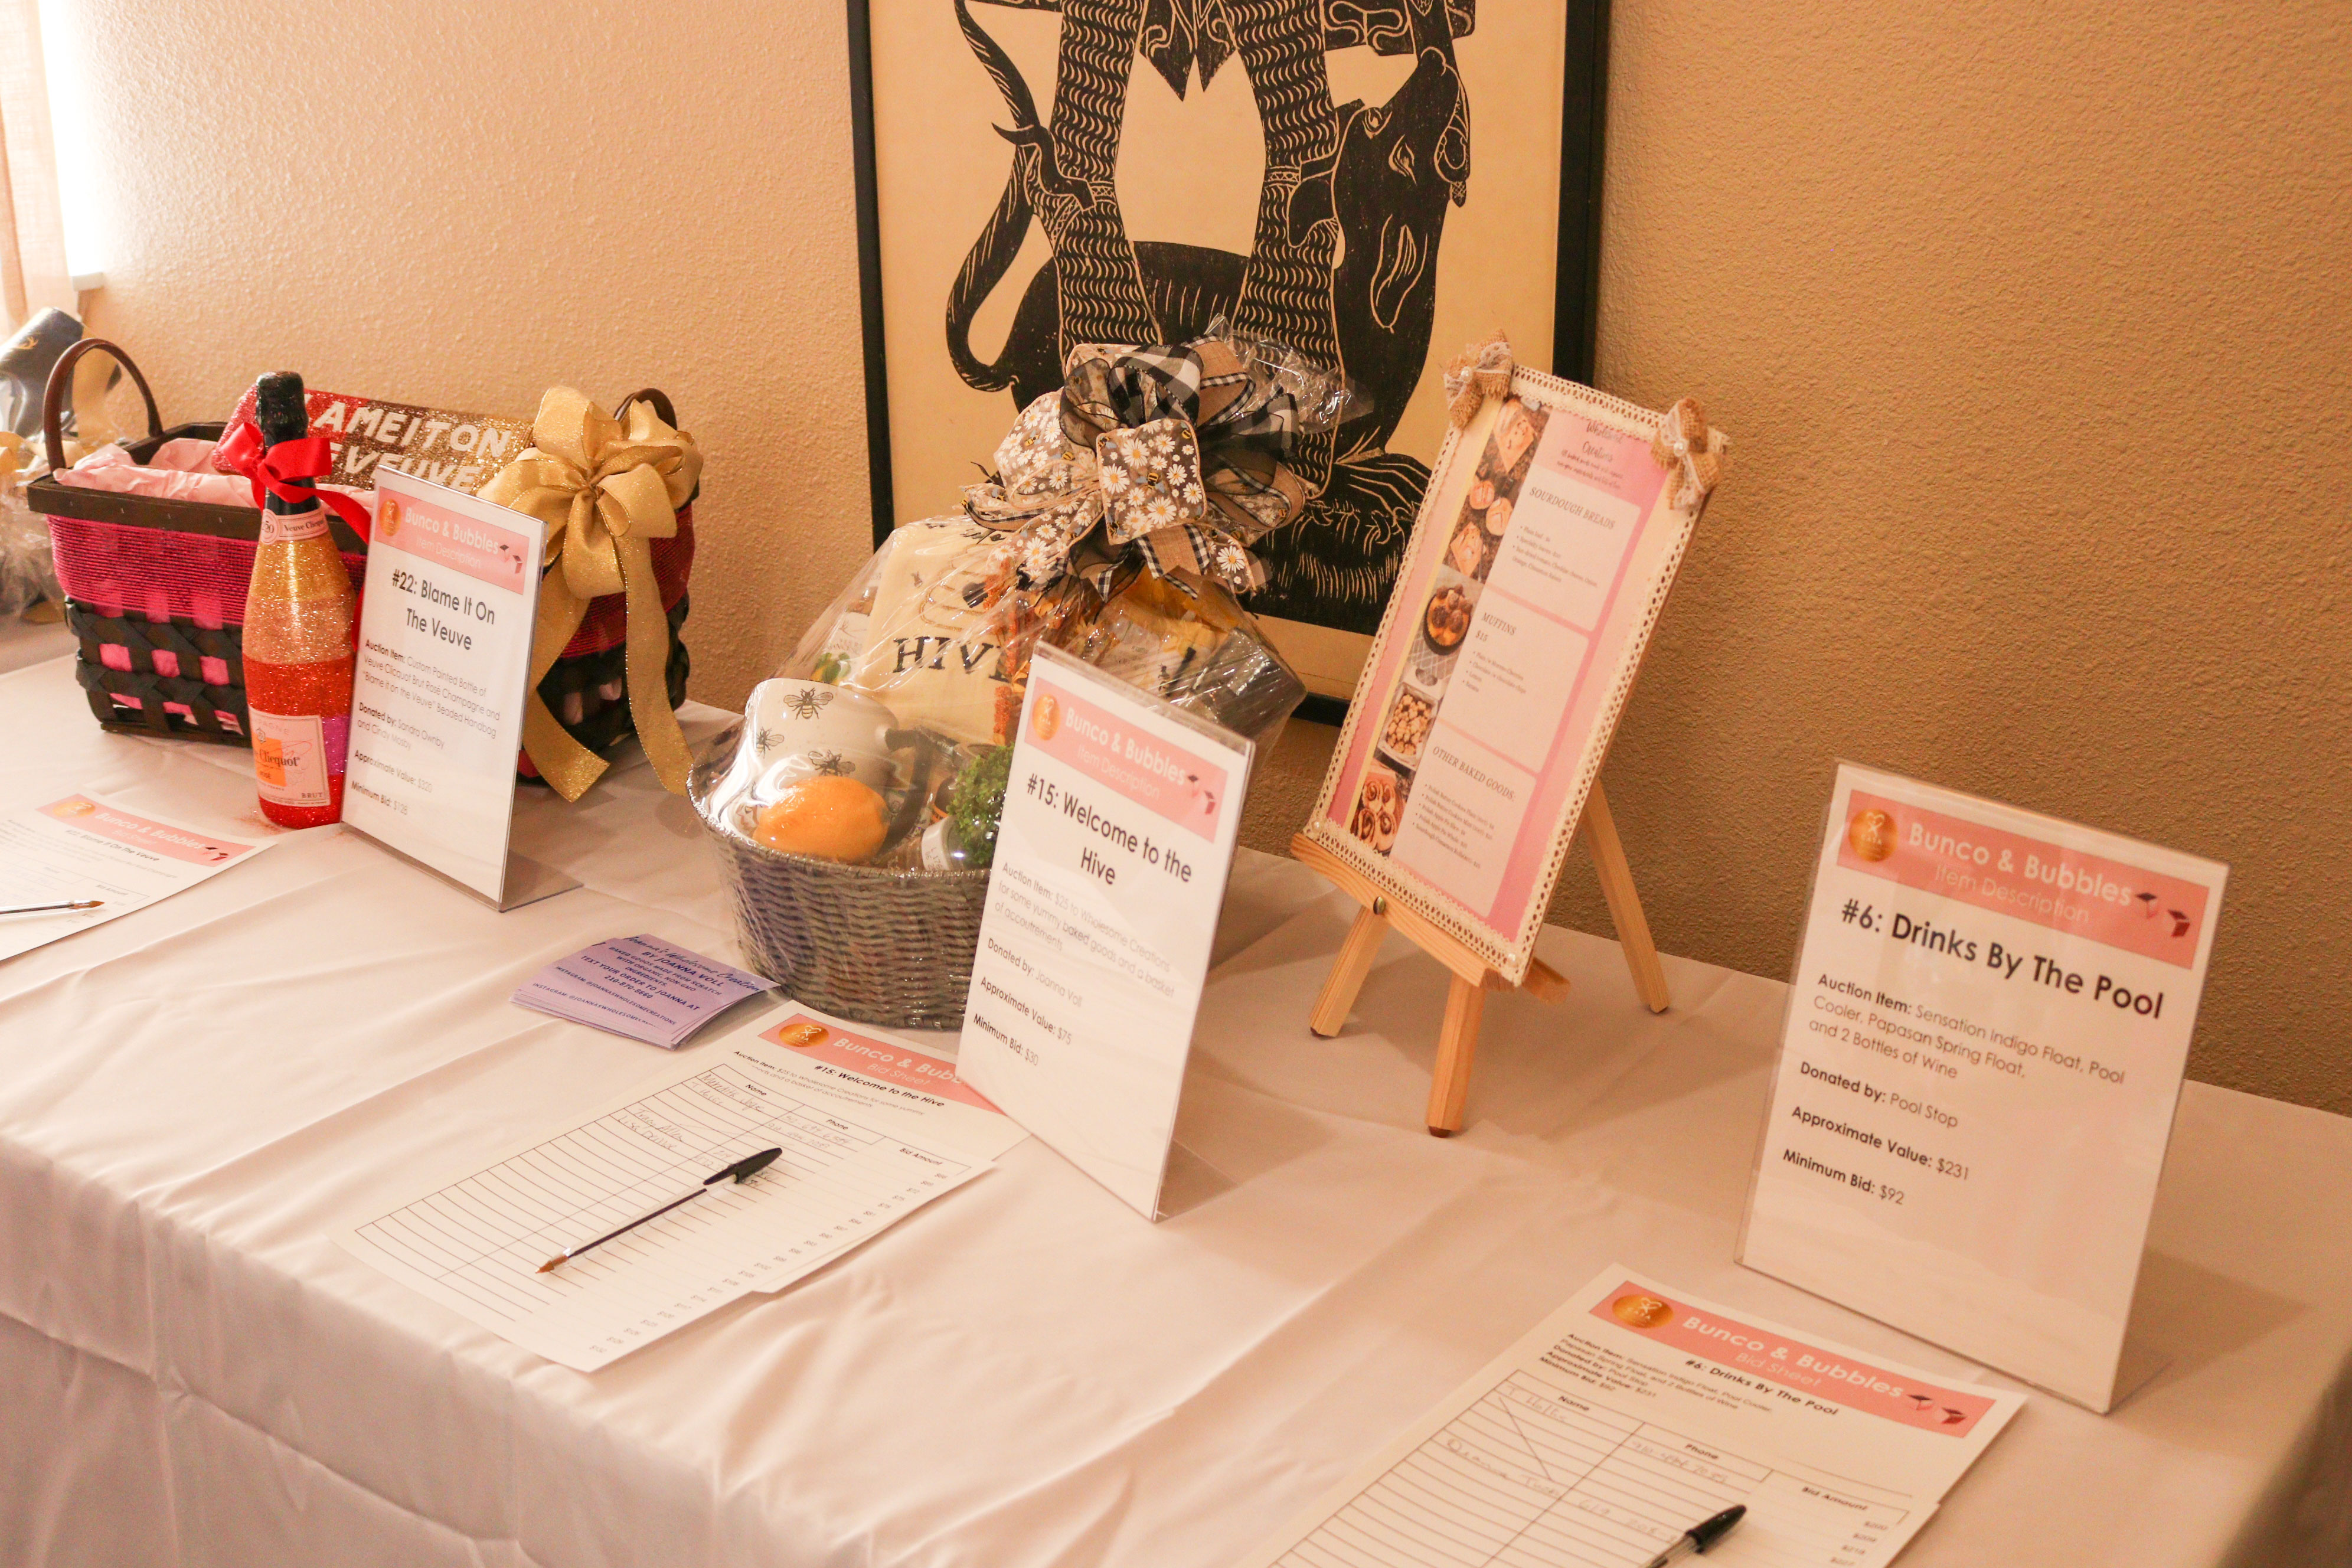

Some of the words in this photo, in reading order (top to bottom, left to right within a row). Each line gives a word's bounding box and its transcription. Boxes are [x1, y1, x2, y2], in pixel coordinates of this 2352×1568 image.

[405, 507, 439, 534] Bunco
[442, 521, 449, 537] &
[453, 526, 499, 555] Bubbles
[1529, 486, 1583, 521] SOURDOUGH
[1583, 508, 1616, 530] BREADS
[436, 543, 482, 569] Description
[392, 569, 419, 594] #22:
[421, 580, 460, 612] Blame
[463, 596, 472, 616] It
[476, 602, 495, 625] On
[407, 608, 427, 632] The
[432, 618, 472, 651] Veuve
[1480, 612, 1517, 637] MUFFINS
[365, 639, 388, 656] Auction
[390, 649, 405, 663] Item:
[407, 656, 432, 674] Custom
[433, 667, 458, 685] Painted
[459, 678, 478, 694] Bottle
[479, 688, 487, 697] of
[892, 636, 1010, 683] HIV
[359, 702, 386, 721] Donated
[387, 714, 397, 727] by:
[437, 703, 463, 722] Beaded
[464, 714, 496, 739] Handbag
[443, 688, 485, 714] Champagne
[486, 709, 501, 721] and
[354, 749, 395, 775] Approximate
[1065, 708, 1109, 746] Bunco
[1110, 731, 1121, 752] &
[1125, 737, 1186, 787] Bubbles
[351, 780, 380, 801] Minimum
[1077, 744, 1100, 767] Item
[1101, 757, 1161, 801] Description
[1432, 745, 1459, 770] OTHER
[1458, 760, 1487, 785] BAKED
[1485, 777, 1517, 803] GOODS:
[94, 812, 139, 829] Bunco
[149, 829, 207, 850] Bubbles
[1027, 773, 1059, 809] #15:
[1064, 791, 1138, 852] Welcome
[1143, 837, 1159, 864] to
[1164, 848, 1192, 882] the
[136, 851, 160, 861] Veuve
[1080, 847, 1116, 886] Hive
[1908, 822, 1990, 865] Bunco
[1997, 850, 2014, 874] &
[2024, 854, 2132, 906] Bubbles
[1002, 862, 1032, 887] Auction
[1033, 880, 1053, 901] Item:
[1935, 865, 1976, 890] Item
[1982, 878, 2090, 923] Description
[1005, 907, 1063, 951] accoutrements
[1010, 889, 1031, 909] some
[1034, 903, 1061, 930] yummy
[1063, 922, 1090, 945] baked
[1118, 957, 1136, 974] and
[1145, 971, 1175, 998] basket
[555, 966, 587, 983] INSTAGRAM:
[581, 955, 599, 965] TEXT
[600, 964, 620, 974] YOUR
[620, 973, 646, 986] ORDER
[655, 990, 688, 1005] JOANNA
[609, 947, 631, 956] BAKED
[631, 955, 653, 966] GOODS
[654, 965, 672, 974] MADE
[672, 973, 691, 982] FROM
[690, 981, 723, 995] SCRATCH
[616, 956, 634, 965] WITH
[664, 976, 697, 991] NON-GMO
[655, 958, 697, 975] JOANNA
[698, 974, 725, 987] VOLL
[988, 937, 1021, 967] Donated
[1023, 959, 1035, 976] by:
[1035, 969, 1066, 997] Joanna
[1841, 898, 1883, 933] #6:
[1891, 913, 1977, 961] Drinks
[1987, 942, 2023, 979] By
[2033, 955, 2084, 994] The
[2093, 974, 2165, 1020] Pool
[533, 982, 568, 998] INSTAGRAM:
[604, 975, 654, 999] 210-870-8660
[981, 976, 1030, 1016] Approximate
[1033, 1008, 1056, 1035] Value:
[1057, 1027, 1072, 1046] $75
[1818, 974, 1872, 1001] Auction
[1876, 991, 1912, 1015] Item:
[1916, 1005, 1986, 1039] Sensation
[1990, 1030, 2038, 1056] Indigo
[2089, 1060, 2125, 1084] Pool
[733, 1050, 760, 1064] Auction
[790, 1032, 809, 1041] CASA
[833, 1038, 894, 1062] Bunco
[897, 1059, 913, 1068] &
[974, 1014, 1008, 1045] Minimum
[1010, 1037, 1023, 1056] Bid:
[1024, 1048, 1039, 1066] $30
[1809, 1020, 1838, 1037] and
[1841, 1028, 1850, 1042] 2
[1853, 1032, 1899, 1059] Bottles
[1902, 1051, 1919, 1064] of
[1922, 1054, 1958, 1079] Wine
[1868, 1012, 1932, 1046] Papasan
[1935, 1035, 1981, 1064] Spring
[814, 1064, 837, 1077] #15:
[838, 1072, 887, 1091] Welcome
[901, 1092, 919, 1100] the
[920, 1097, 946, 1107] Hive
[867, 1063, 890, 1074] Bid
[890, 1070, 931, 1086] Sheet
[1800, 1061, 1861, 1093] Donated
[1864, 1084, 1887, 1103] by:
[1890, 1093, 1922, 1115] Pool
[1925, 1105, 1958, 1129] Stop
[744, 1083, 767, 1097] Name
[826, 1118, 849, 1131] Phone
[912, 1152, 943, 1166] Amount
[1791, 1106, 1882, 1148] Approximate
[1887, 1139, 1932, 1168] Value:
[1936, 1158, 1969, 1180] $231
[1783, 1148, 1846, 1183] Minimum
[1850, 1174, 1876, 1194] Bid:
[1879, 1184, 1905, 1206] $92
[1682, 1316, 1765, 1352] Bunco
[1770, 1347, 1789, 1361] &
[1795, 1354, 1905, 1398] Bubbles
[1734, 1353, 1763, 1368] Bid
[1766, 1363, 1822, 1387] Sheet
[1685, 1359, 1707, 1371] #6:
[1710, 1367, 1753, 1387] Drinks
[1755, 1382, 1773, 1394] By
[1776, 1390, 1802, 1403] The
[1805, 1399, 1840, 1416] Pool
[1557, 1395, 1590, 1412] Name
[1685, 1443, 1720, 1461] Phone
[1822, 1494, 1868, 1510] Amount
